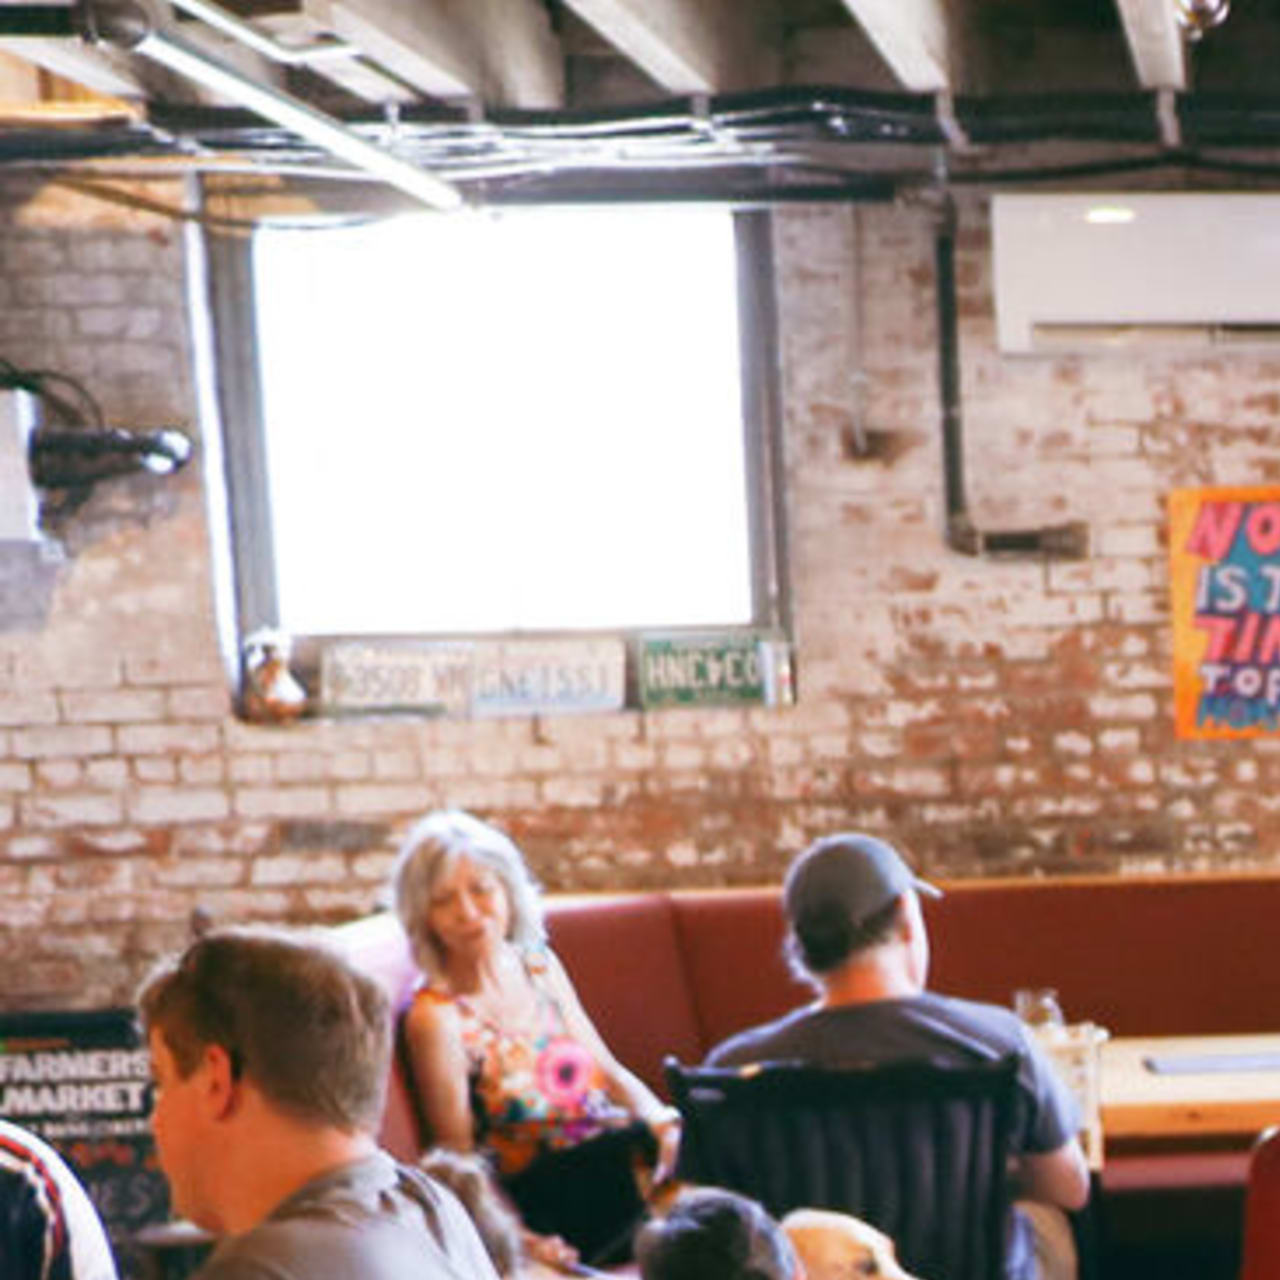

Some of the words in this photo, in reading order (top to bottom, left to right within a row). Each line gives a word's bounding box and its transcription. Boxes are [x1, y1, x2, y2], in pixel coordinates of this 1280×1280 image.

[1196, 564, 1249, 612] IS
[1199, 663, 1262, 698] TO
[0, 1050, 151, 1082] FARMERS
[0, 1082, 145, 1115] MARKET
